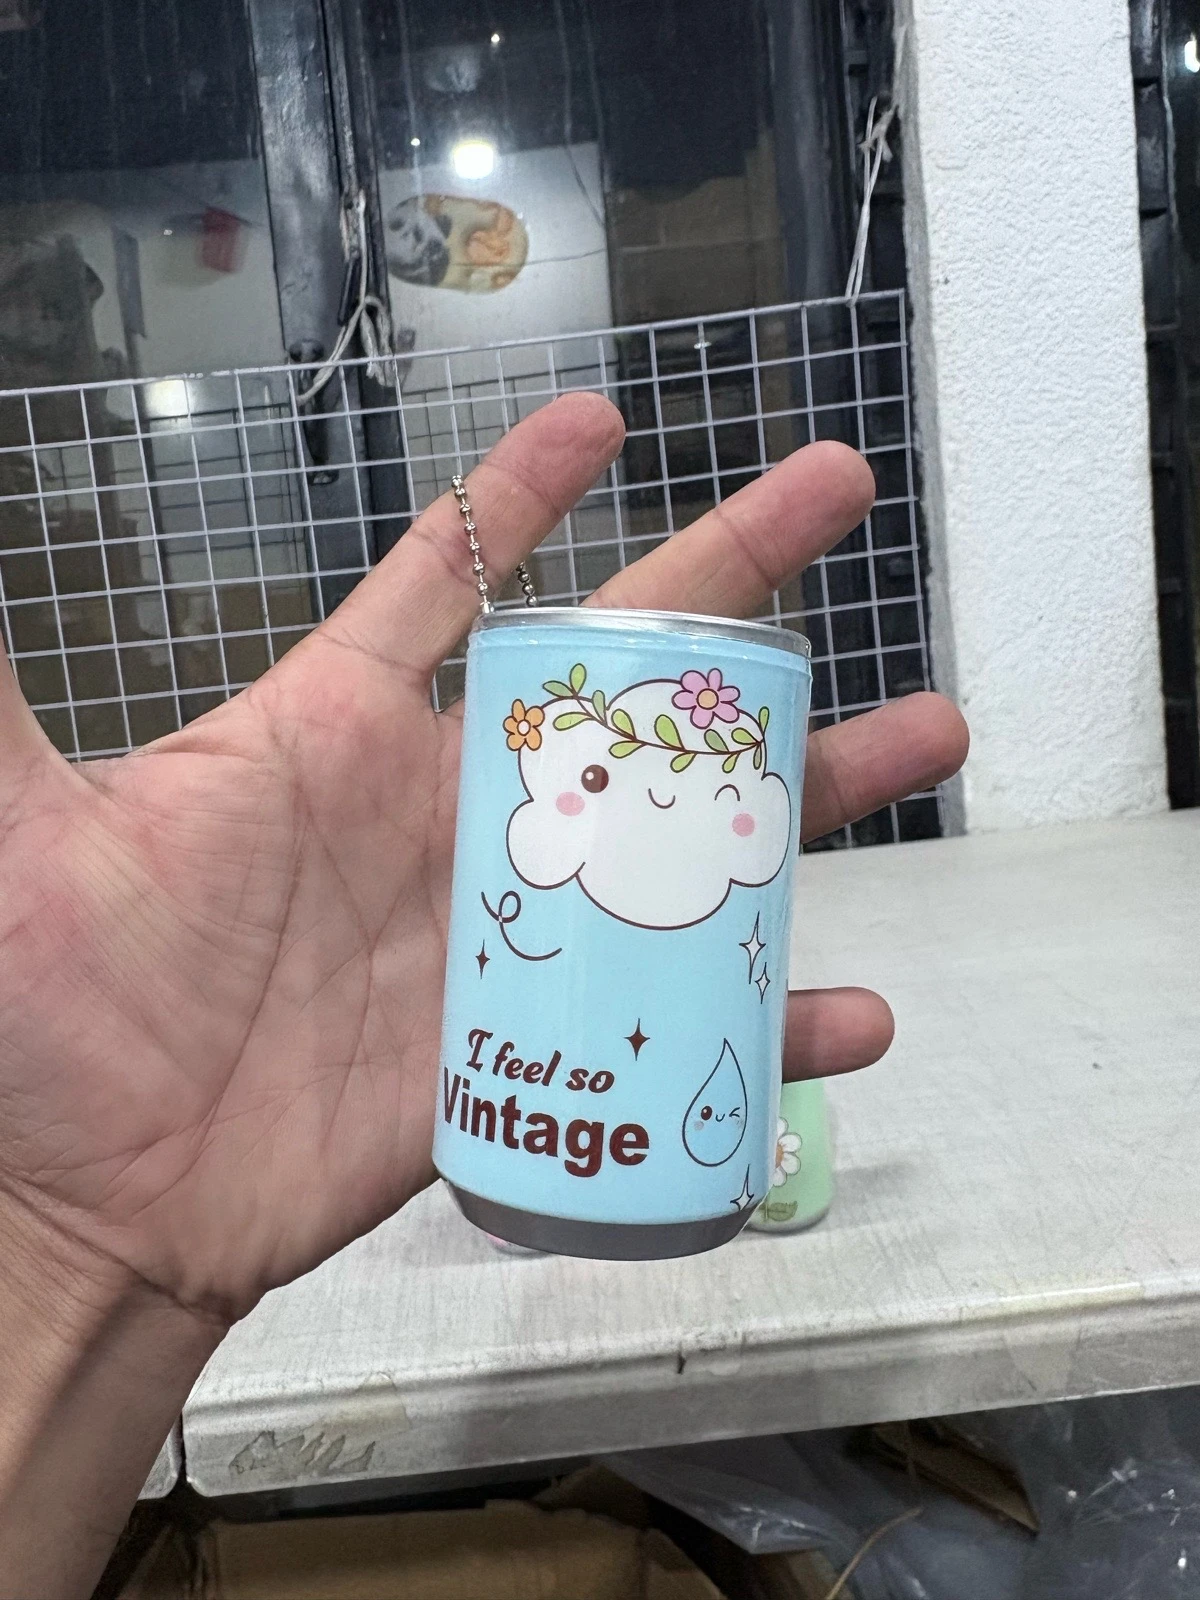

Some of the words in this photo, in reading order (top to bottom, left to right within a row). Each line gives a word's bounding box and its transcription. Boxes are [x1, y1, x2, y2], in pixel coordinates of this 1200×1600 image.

[466, 1028, 494, 1073] I
[492, 1041, 562, 1087] feel
[564, 1068, 615, 1094] so
[443, 1066, 650, 1178] Vintage
